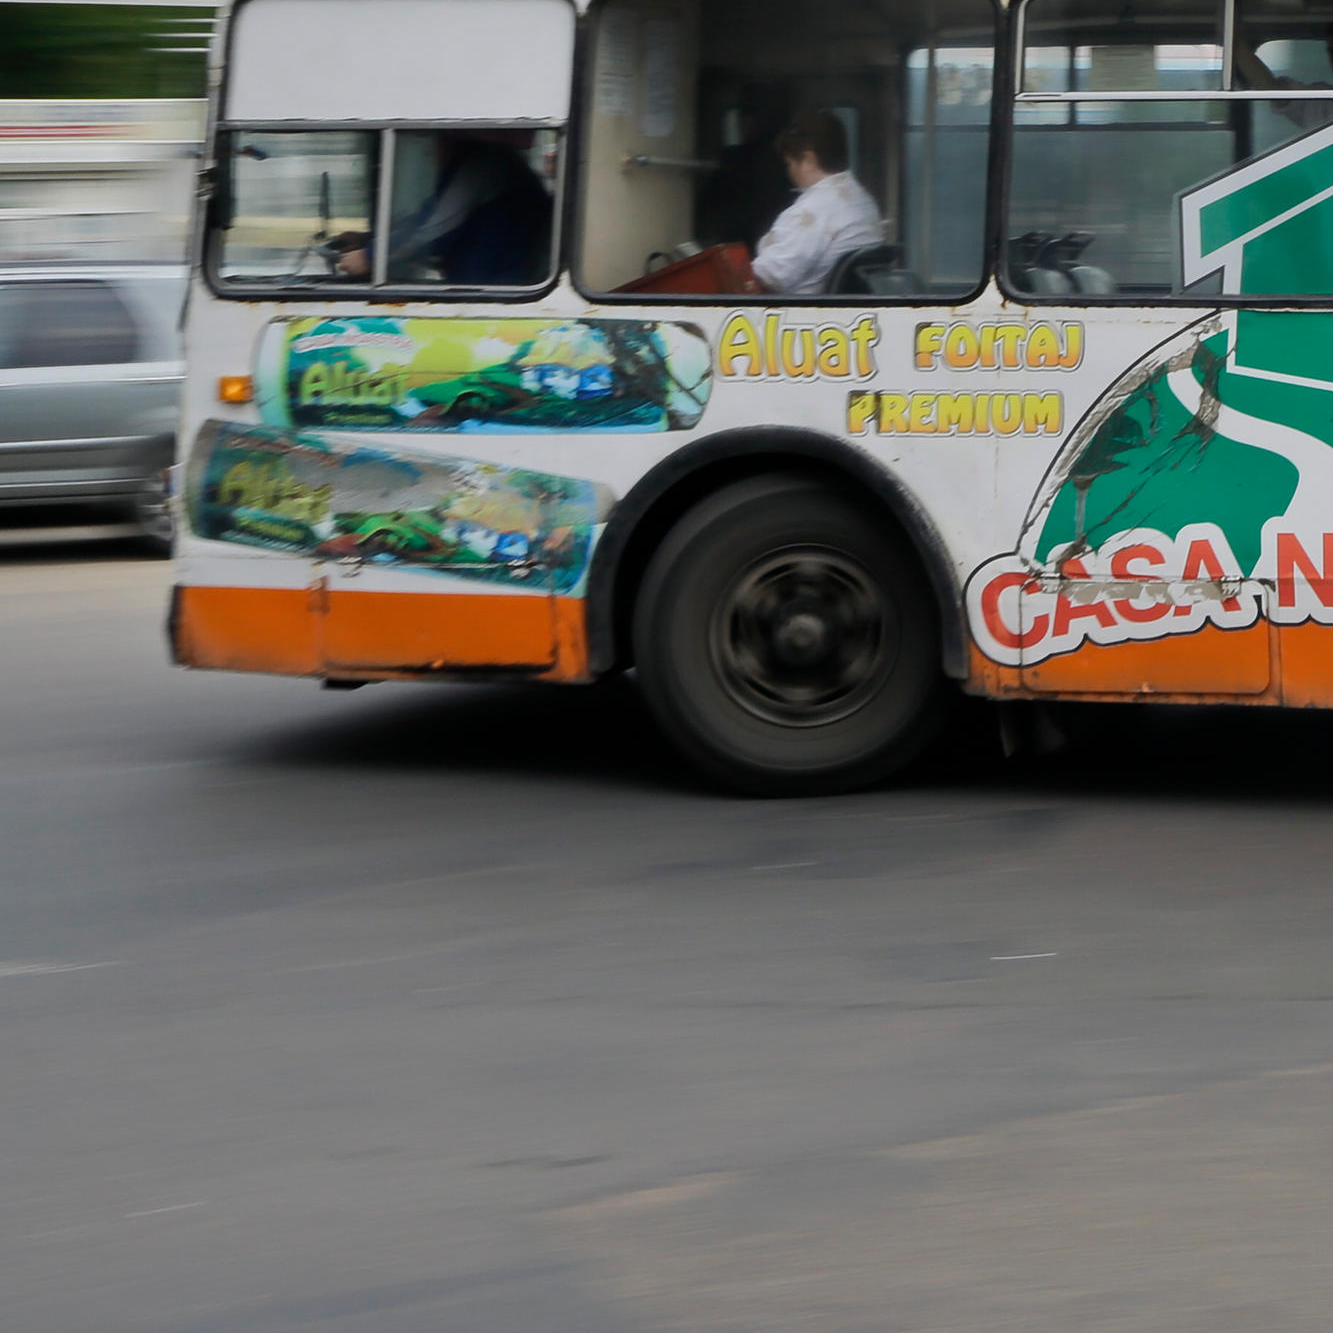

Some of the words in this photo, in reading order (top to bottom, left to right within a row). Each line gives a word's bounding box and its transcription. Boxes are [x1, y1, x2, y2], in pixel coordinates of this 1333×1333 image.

[718, 310, 878, 378] Aluat
[915, 323, 1082, 369] FOITAJ
[847, 392, 1062, 434] PREMIUM
[980, 537, 1242, 649] CASA
